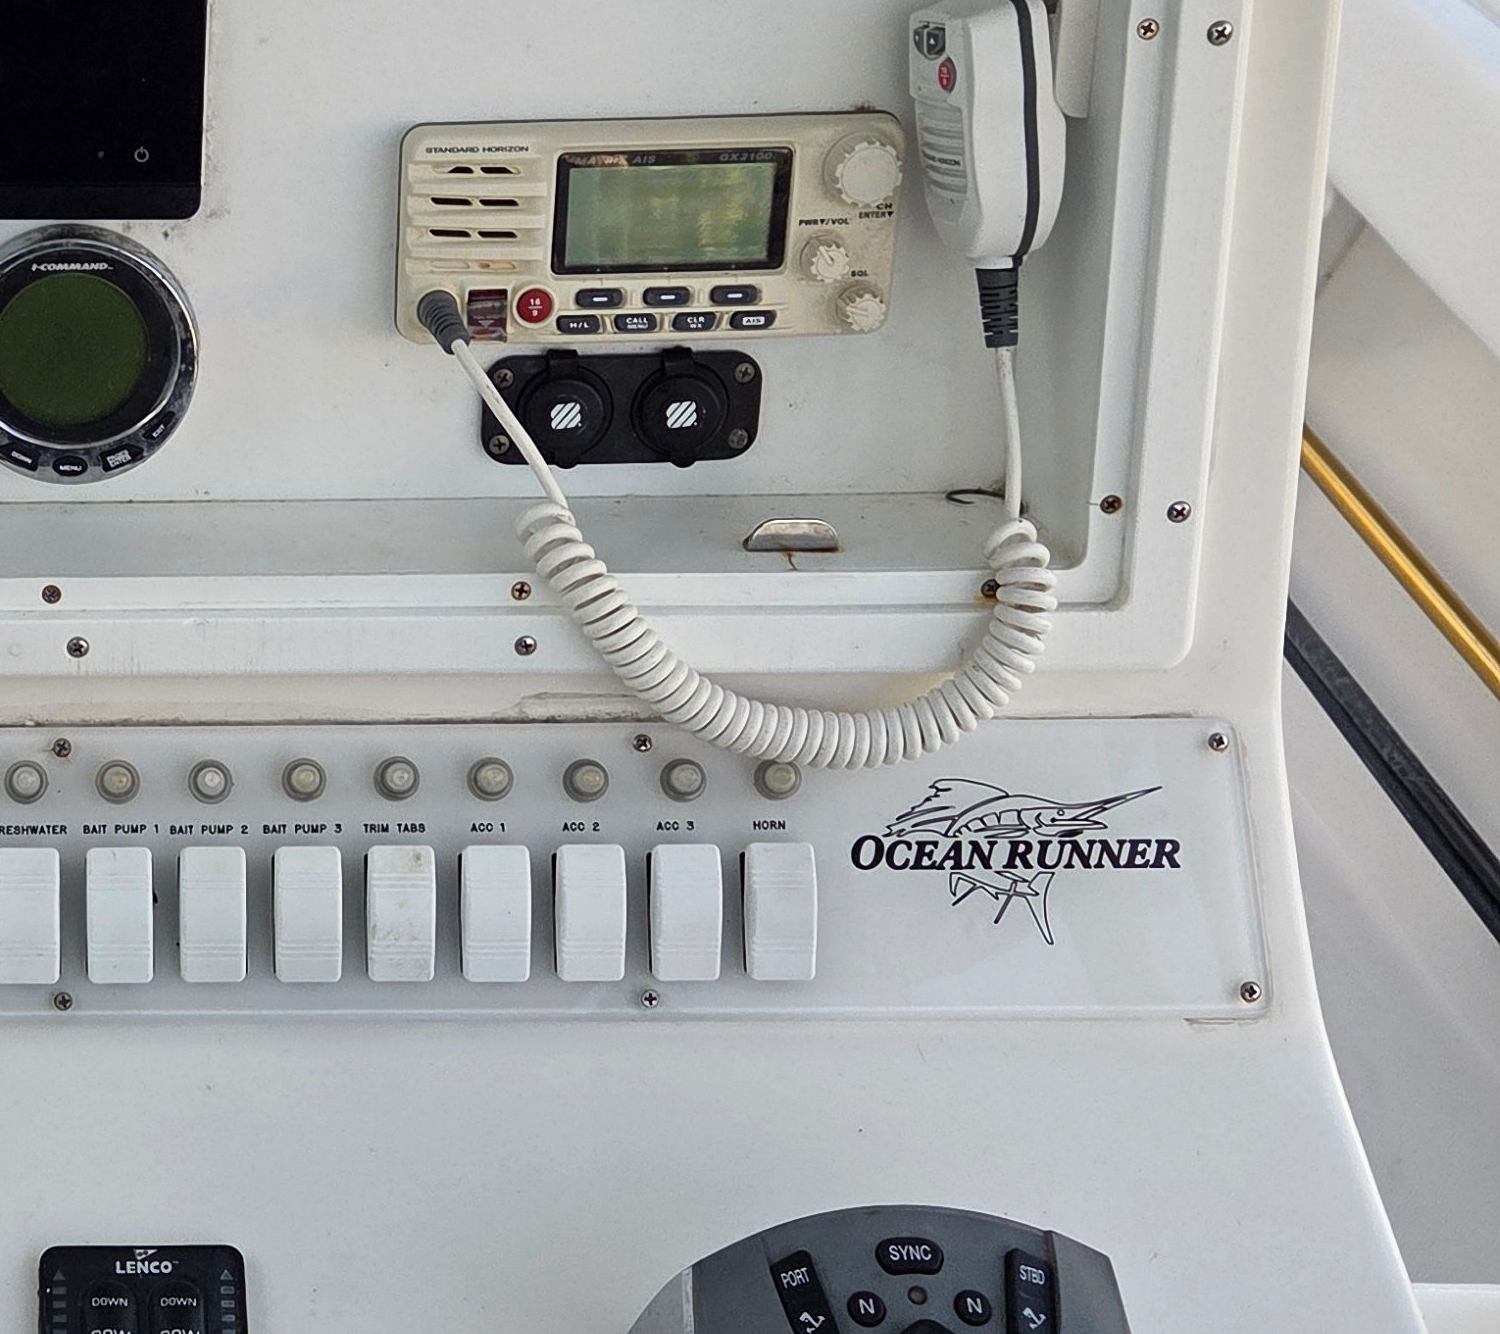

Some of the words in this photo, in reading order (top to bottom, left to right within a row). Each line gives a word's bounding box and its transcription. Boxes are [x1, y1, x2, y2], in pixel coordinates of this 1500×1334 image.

[425, 146, 480, 154] STANDARD
[482, 145, 530, 154] HORIZON
[876, 202, 893, 211] CH
[529, 297, 542, 307] 16
[569, 321, 590, 329] H/L
[625, 316, 649, 325] CALL
[686, 315, 706, 325] CLR
[58, 463, 83, 473] MENU
[82, 823, 109, 835] BAIT
[113, 823, 148, 835] PUMP
[154, 823, 160, 834] 1
[169, 824, 195, 835] BAIT
[201, 824, 235, 835] PUMP
[240, 823, 249, 834] 2
[262, 823, 287, 835] BAIT
[294, 823, 328, 835] PUMP
[333, 823, 343, 834] 3
[363, 823, 391, 834] TRIM
[396, 822, 426, 833] TABS
[470, 822, 495, 833] ACC
[500, 822, 507, 832] 1
[562, 821, 587, 832] ACC
[591, 821, 601, 832] 2
[656, 821, 681, 832] ACC
[685, 820, 695, 831] 3
[752, 819, 787, 831] HORN
[850, 835, 998, 871] OCEAN
[1002, 838, 1181, 870] RUNNER
[888, 1244, 932, 1262] SYNC
[115, 1260, 173, 1274] LENCO
[780, 1267, 811, 1289] PORT
[1018, 1264, 1046, 1286] STBD
[91, 1297, 129, 1307] DOWN
[160, 1297, 197, 1307] DOWN
[859, 1298, 875, 1316] N
[966, 1296, 982, 1314] N
